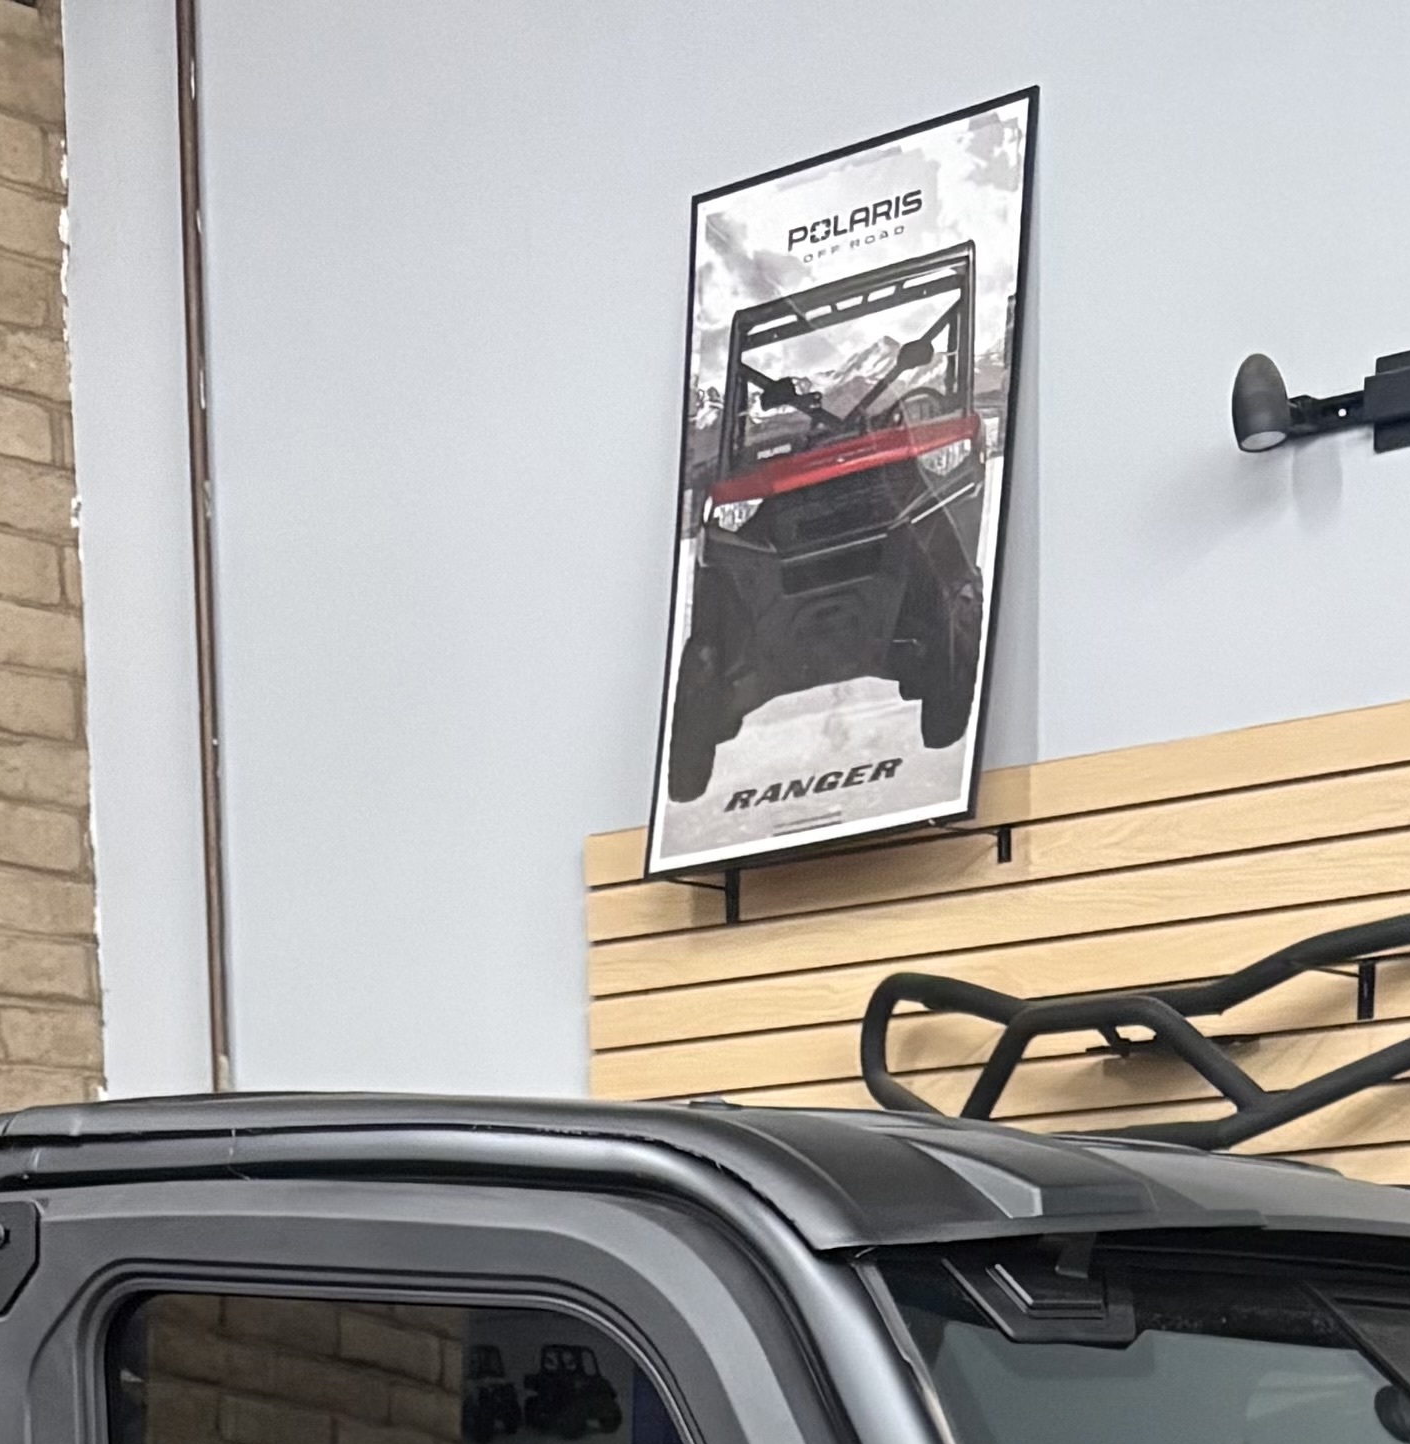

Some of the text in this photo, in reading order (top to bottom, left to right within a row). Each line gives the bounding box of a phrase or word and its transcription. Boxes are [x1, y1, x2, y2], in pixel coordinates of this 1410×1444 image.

[788, 189, 923, 252] POLARIS
[803, 225, 905, 263] OFF ROAD
[724, 757, 903, 813] RANGER
